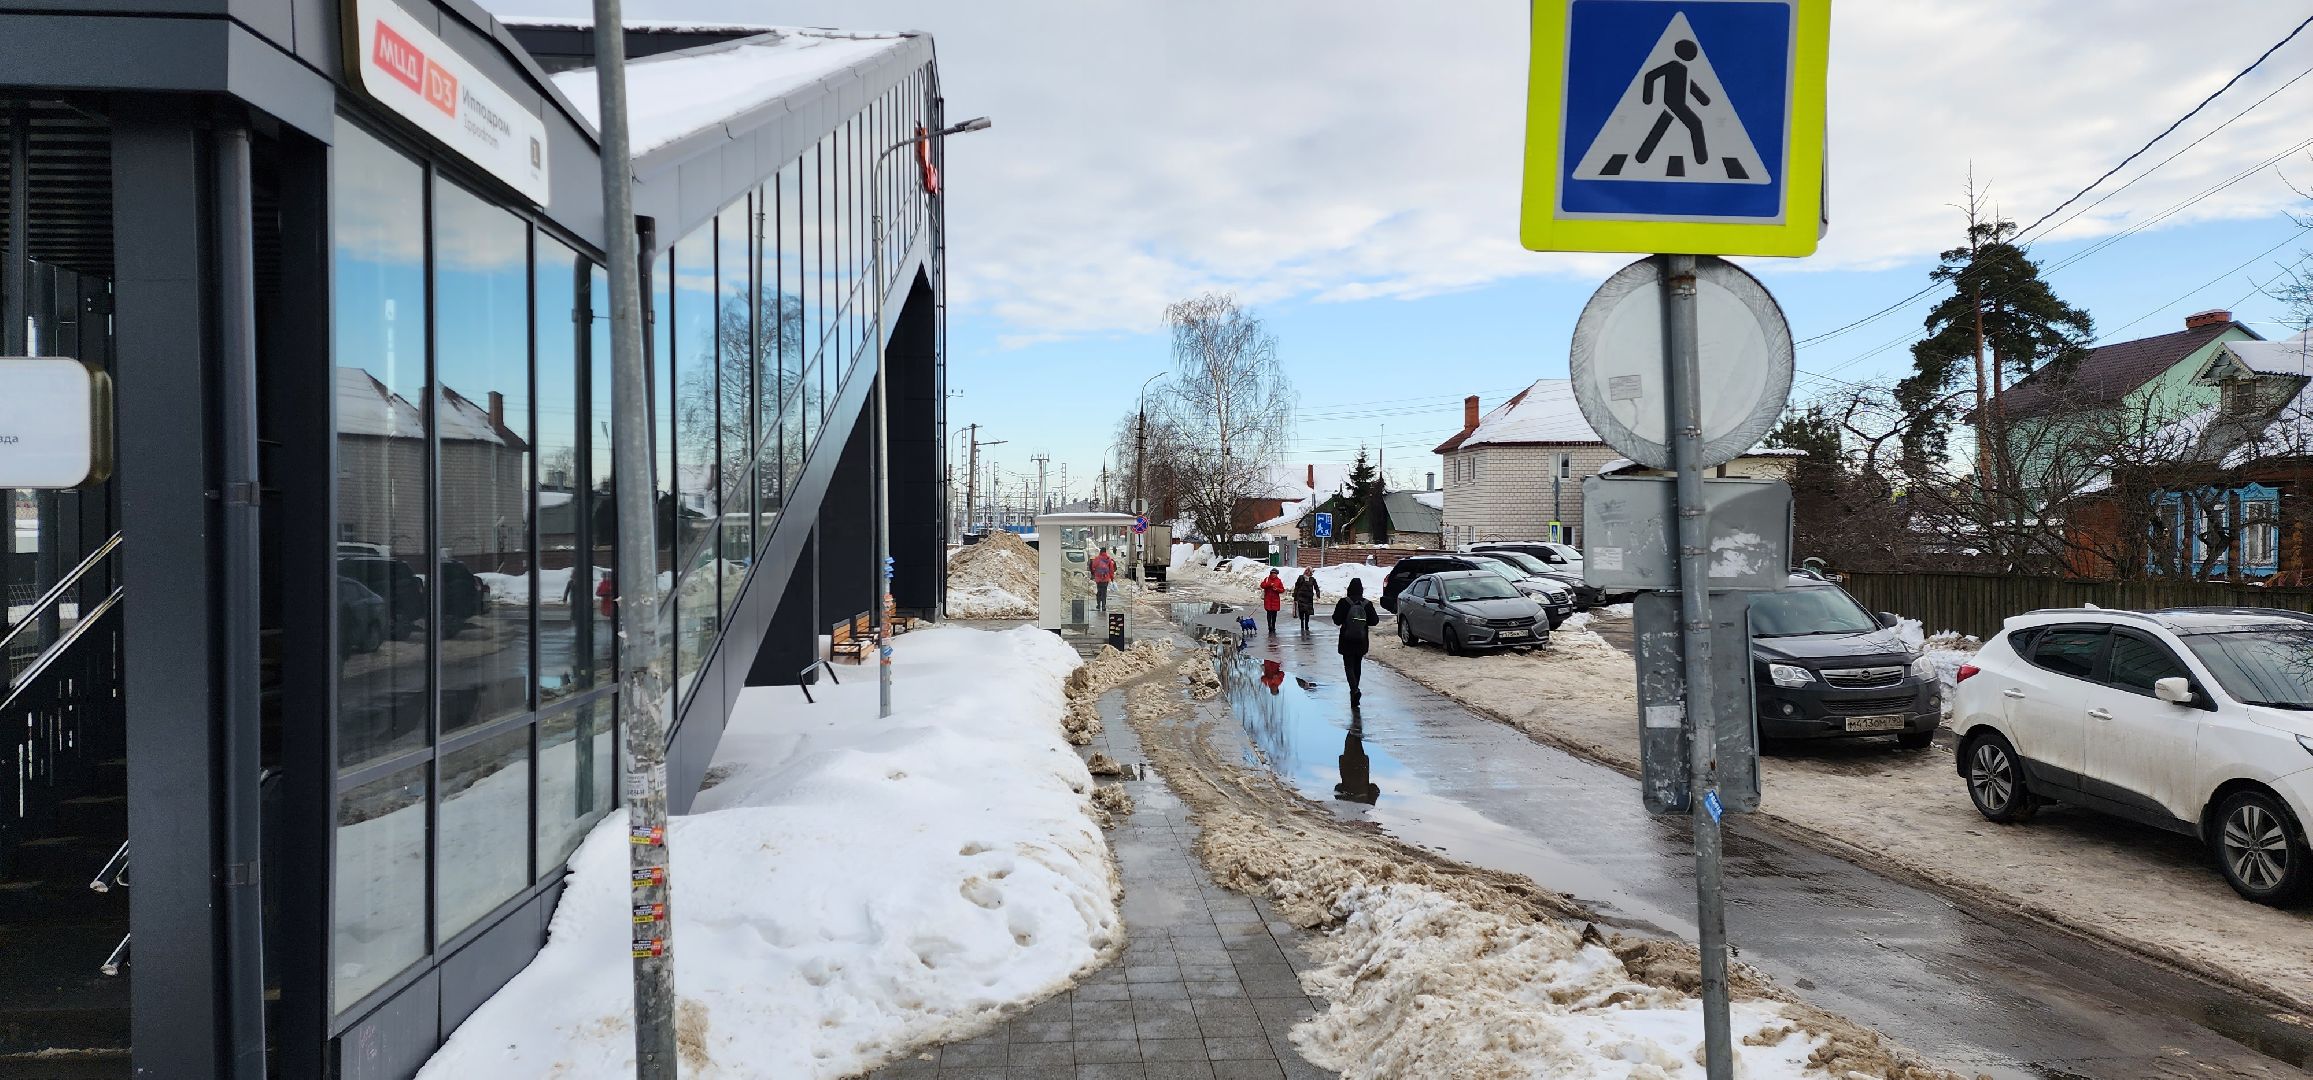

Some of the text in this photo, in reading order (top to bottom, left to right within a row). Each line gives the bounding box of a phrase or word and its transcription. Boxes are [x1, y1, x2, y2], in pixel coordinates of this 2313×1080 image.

[379, 35, 454, 109] МЦД D3
[462, 85, 511, 137] Ипподром
